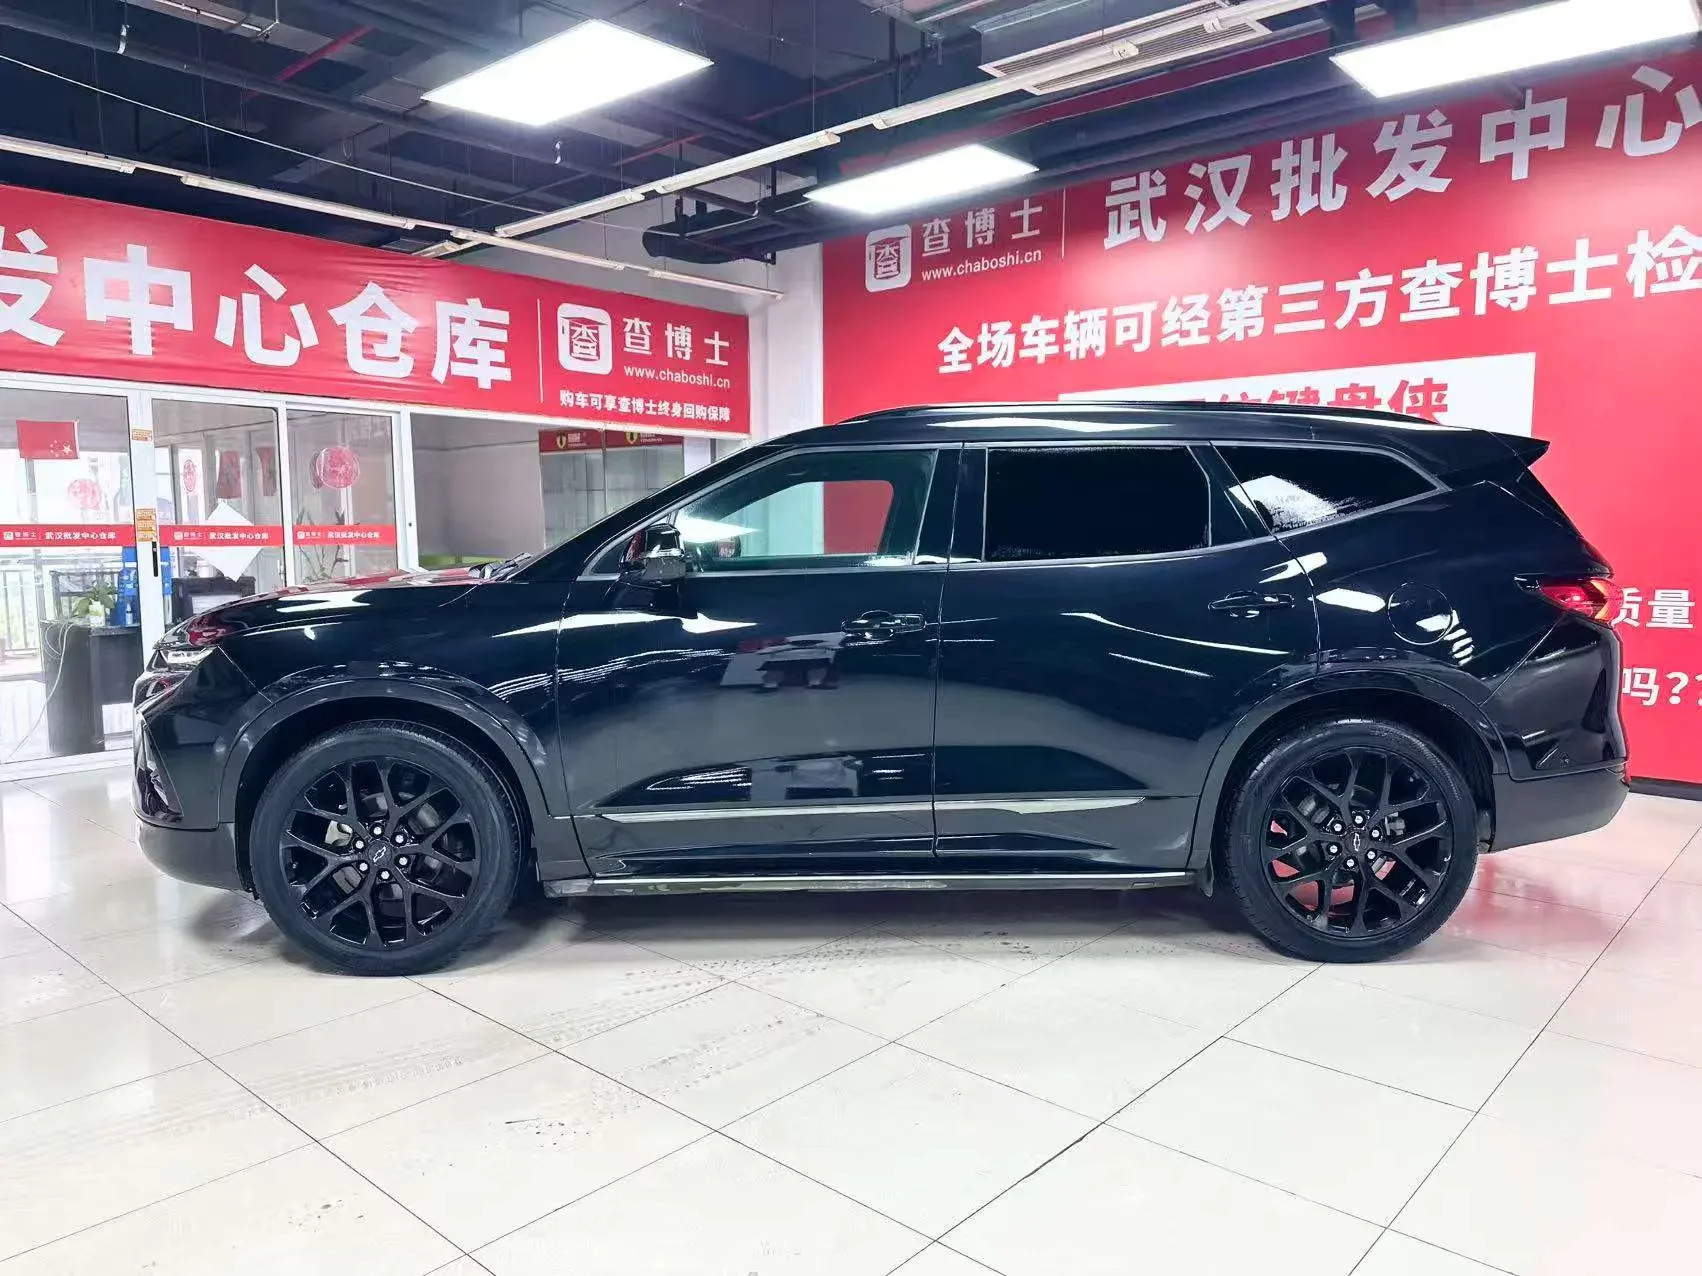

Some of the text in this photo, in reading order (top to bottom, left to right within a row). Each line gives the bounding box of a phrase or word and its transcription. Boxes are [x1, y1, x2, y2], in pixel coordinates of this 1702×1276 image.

[1104, 65, 1702, 250] 武汉批发中心
[922, 199, 1043, 257] 查博士
[922, 250, 1042, 281] www.chaboshi.cn
[937, 224, 1702, 374] 全场车辆可经第三方查博士检
[623, 317, 730, 367] 查博士
[623, 365, 731, 389] www.chaboshi.cn
[559, 389, 731, 422] 购车可享查博士终身回购保障
